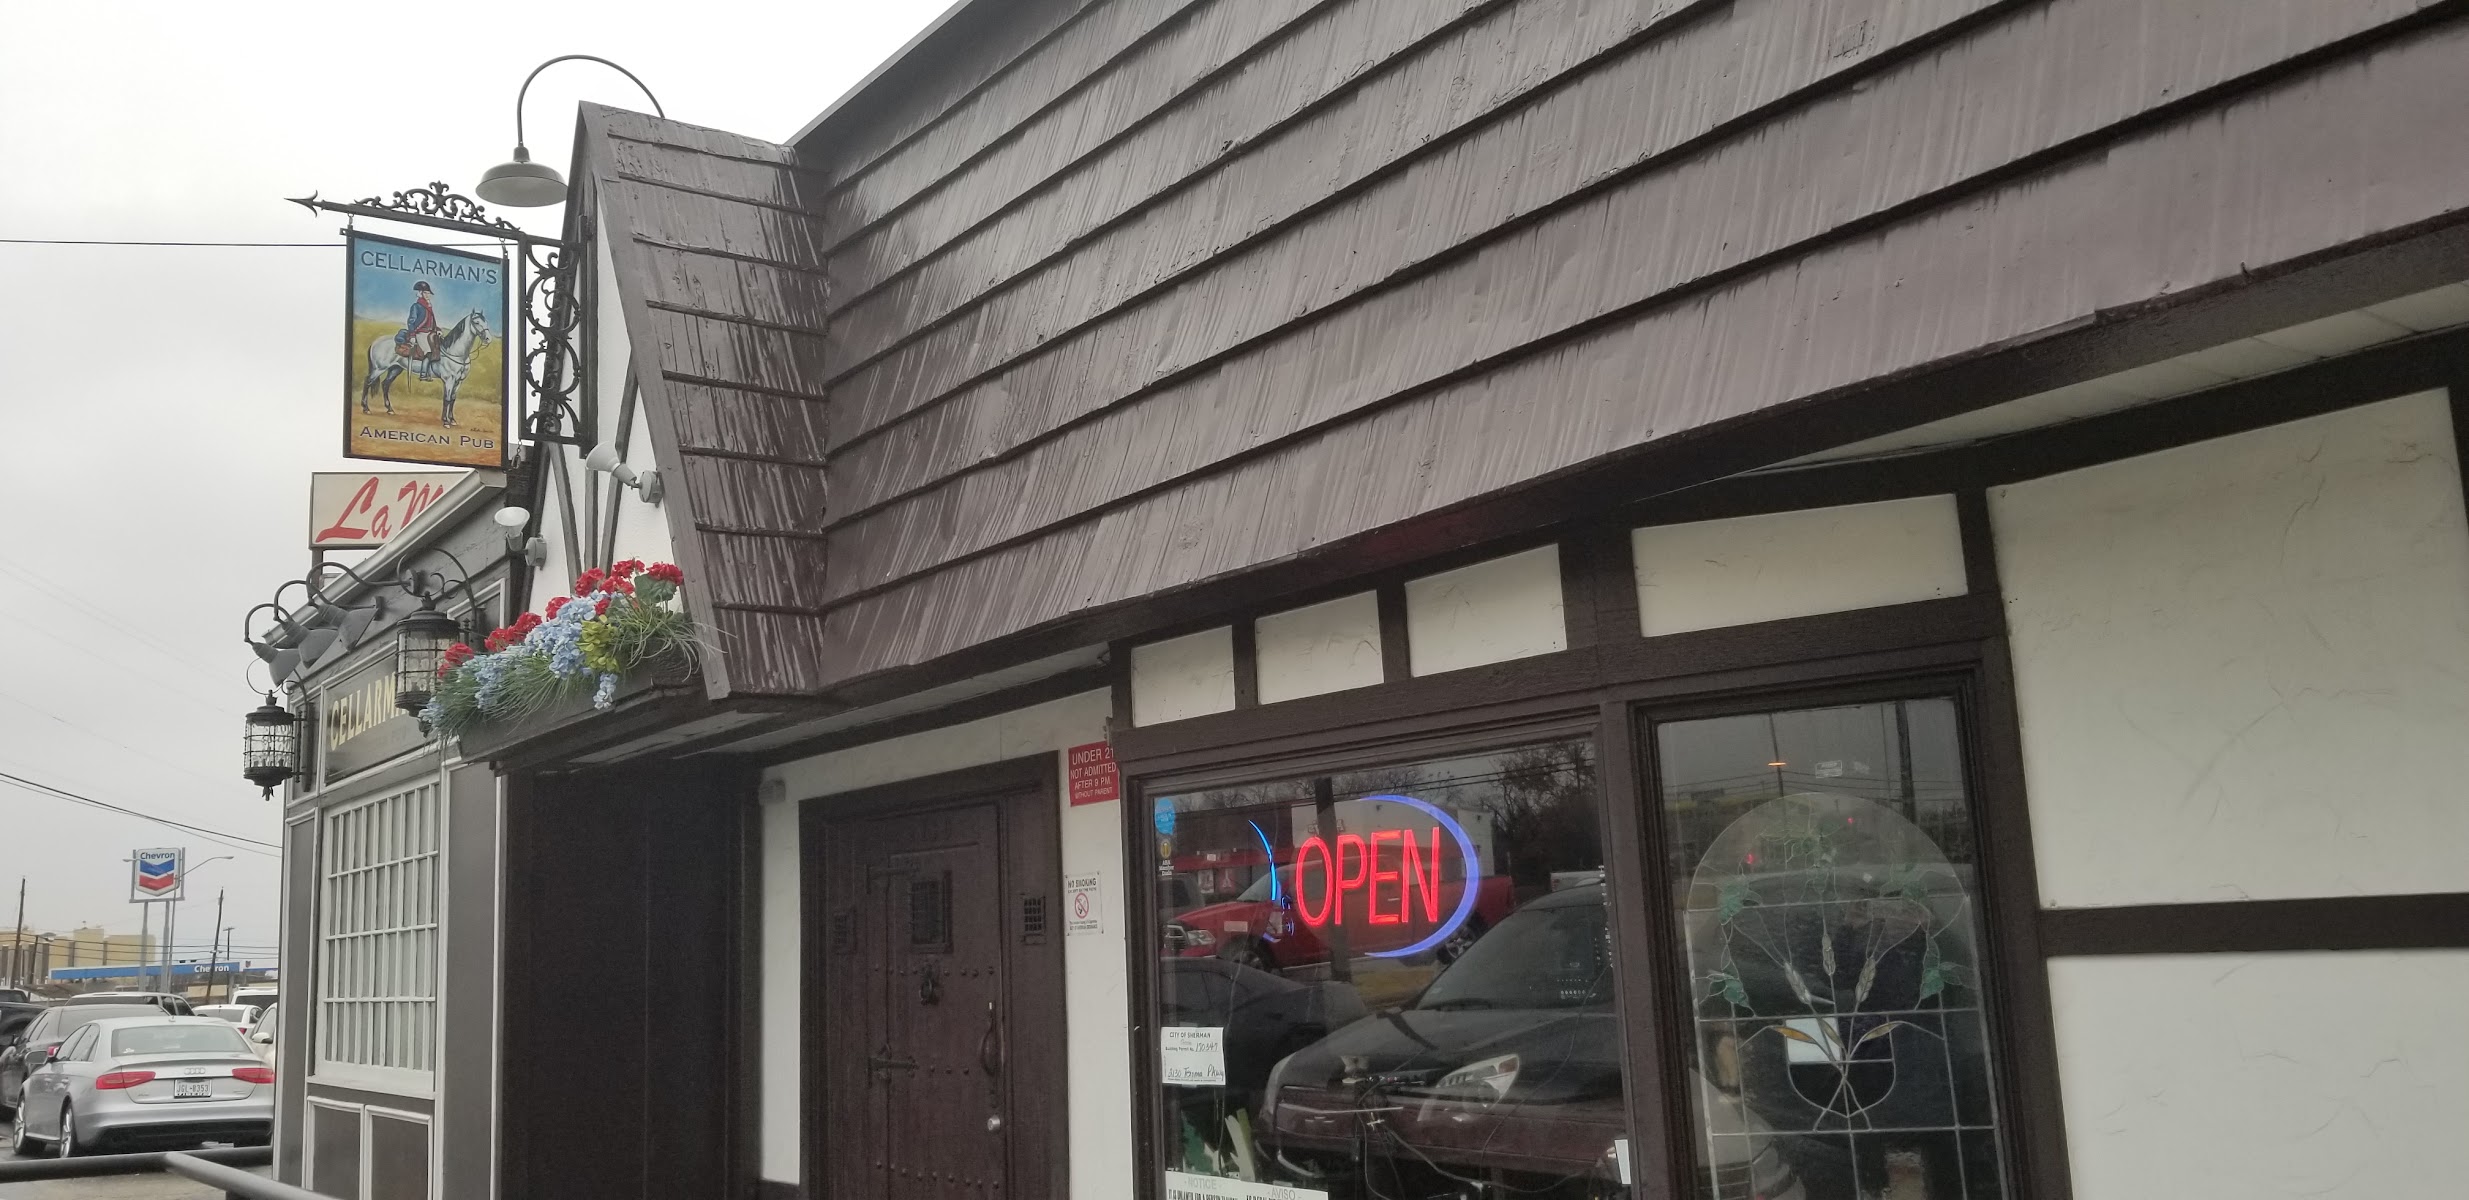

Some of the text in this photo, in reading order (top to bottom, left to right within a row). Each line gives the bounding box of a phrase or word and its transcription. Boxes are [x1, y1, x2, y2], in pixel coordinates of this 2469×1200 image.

[361, 251, 497, 285] CELLARMAN'S
[315, 476, 444, 543] La M
[330, 671, 408, 752] CELLARM
[1072, 747, 1114, 765] UNDER 21
[1070, 762, 1116, 780] NOT ADMITTED
[1075, 779, 1093, 790] AFTER
[1095, 778, 1099, 787] 9
[1075, 787, 1112, 799] WITHOUT PARENT
[140, 852, 175, 860] Chevron
[1076, 878, 1096, 887] SMOKING
[1296, 826, 1440, 927] OPEN
[194, 964, 230, 973] Cheron
[1188, 1176, 1217, 1190] NOTICE
[1271, 1187, 1296, 1200] AVISO
